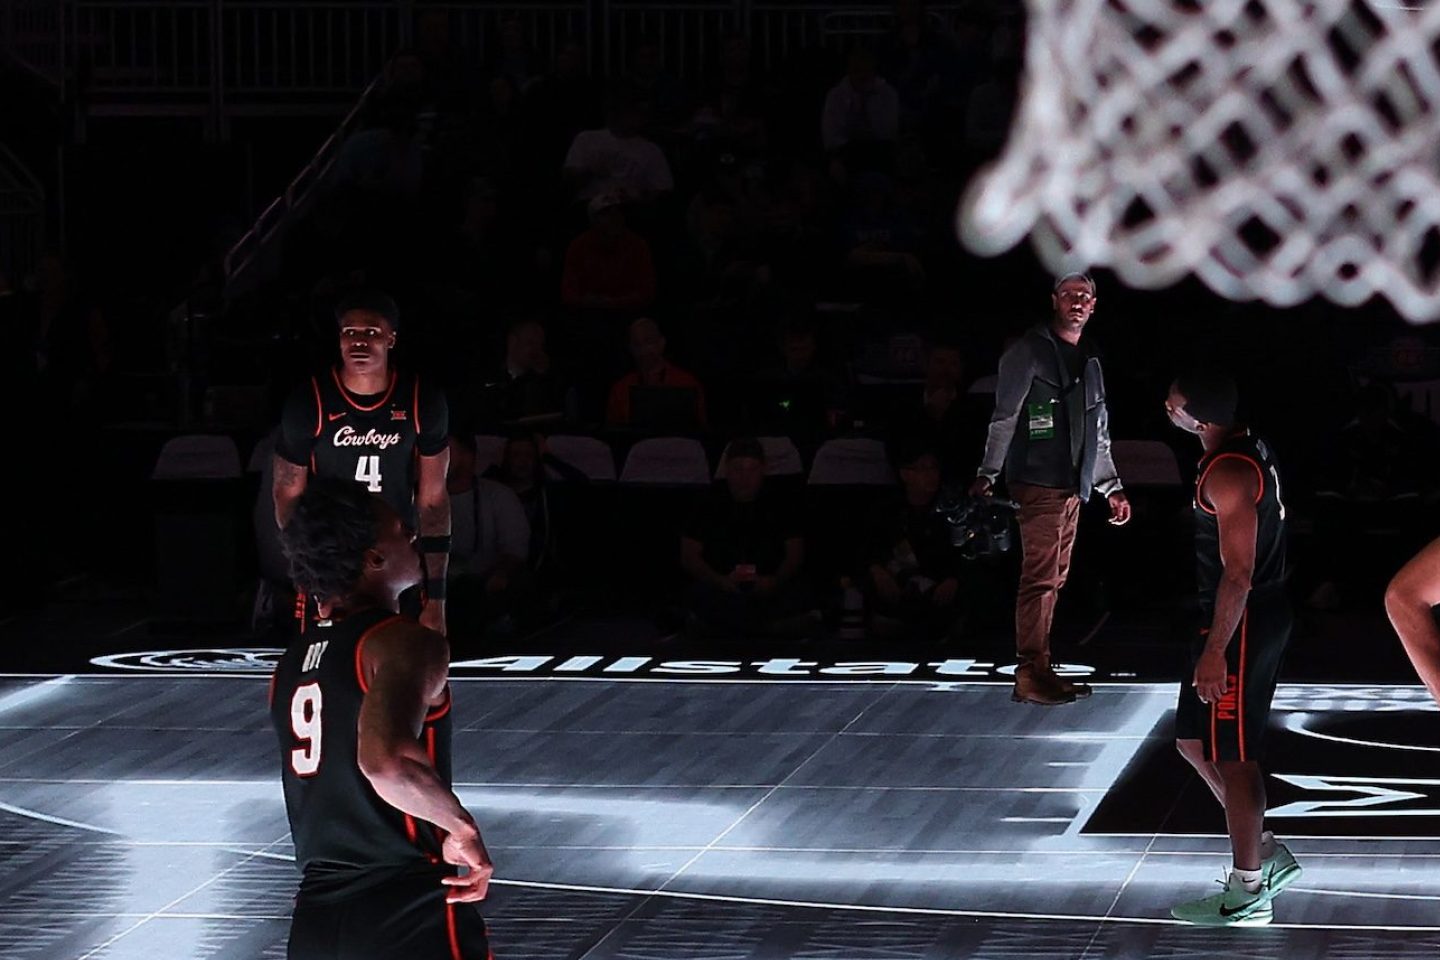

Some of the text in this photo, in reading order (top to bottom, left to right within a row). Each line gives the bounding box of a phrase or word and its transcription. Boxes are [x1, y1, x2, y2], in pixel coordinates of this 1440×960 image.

[333, 425, 401, 449] Cowboys
[354, 455, 383, 493] 4
[289, 681, 324, 777] 9
